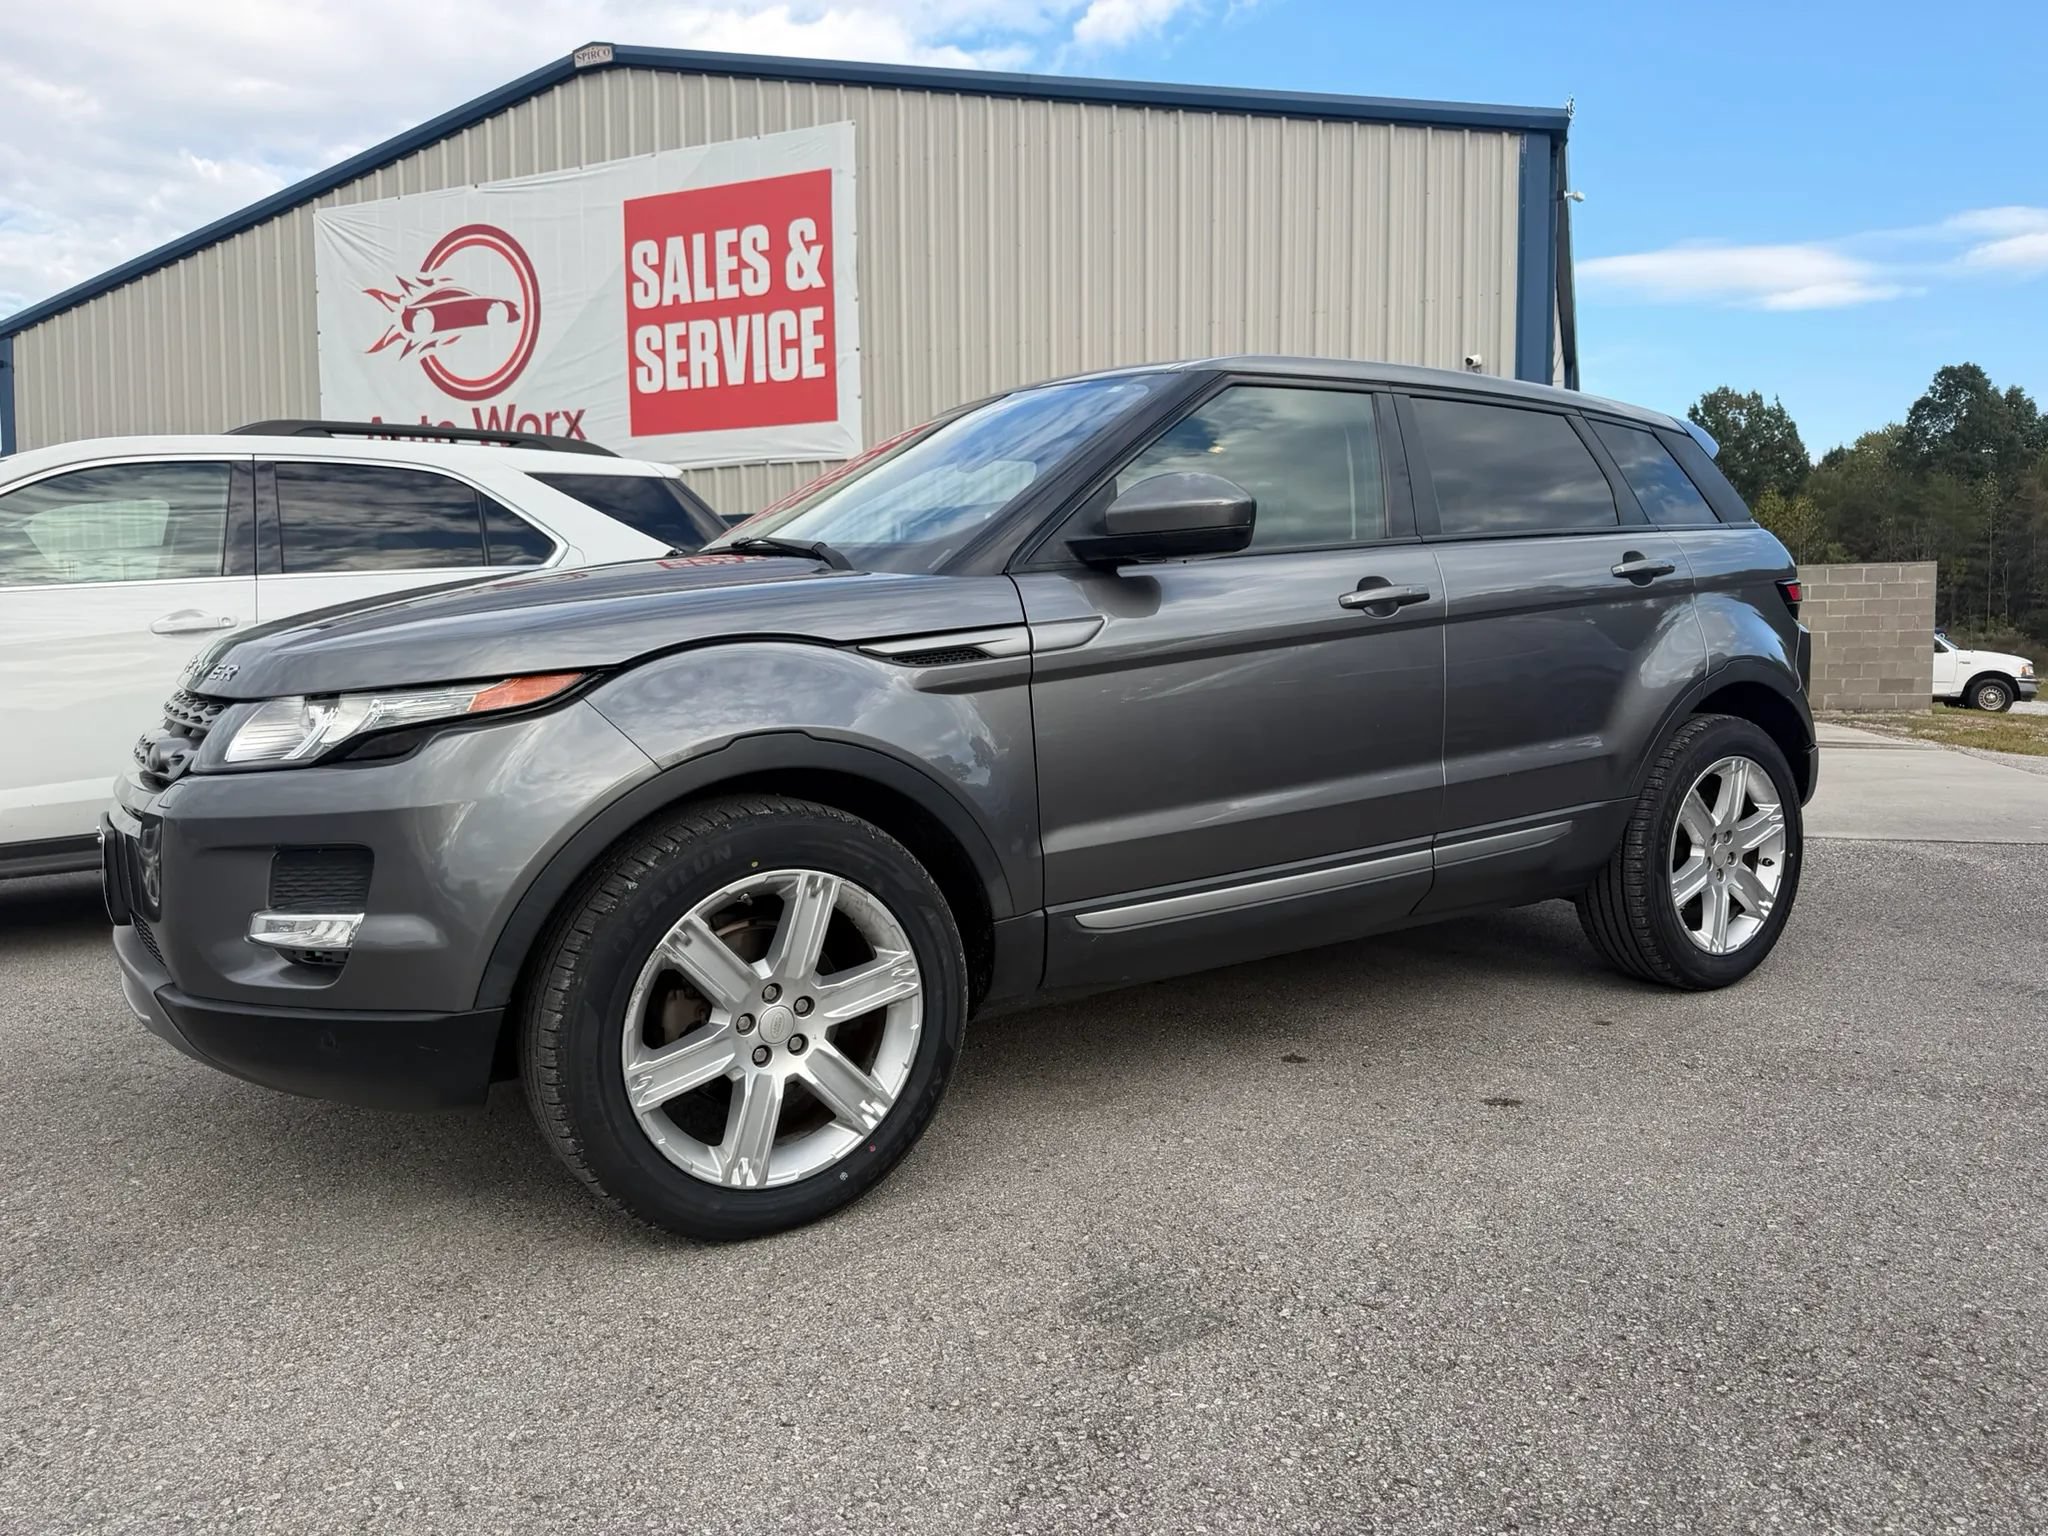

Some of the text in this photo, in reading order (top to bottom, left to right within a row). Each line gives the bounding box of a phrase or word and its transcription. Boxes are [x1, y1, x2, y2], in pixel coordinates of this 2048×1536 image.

[576, 48, 611, 62] SPIRCO
[632, 218, 826, 309] SALES &
[635, 307, 826, 394] SERVICE
[472, 404, 587, 446] Worx
